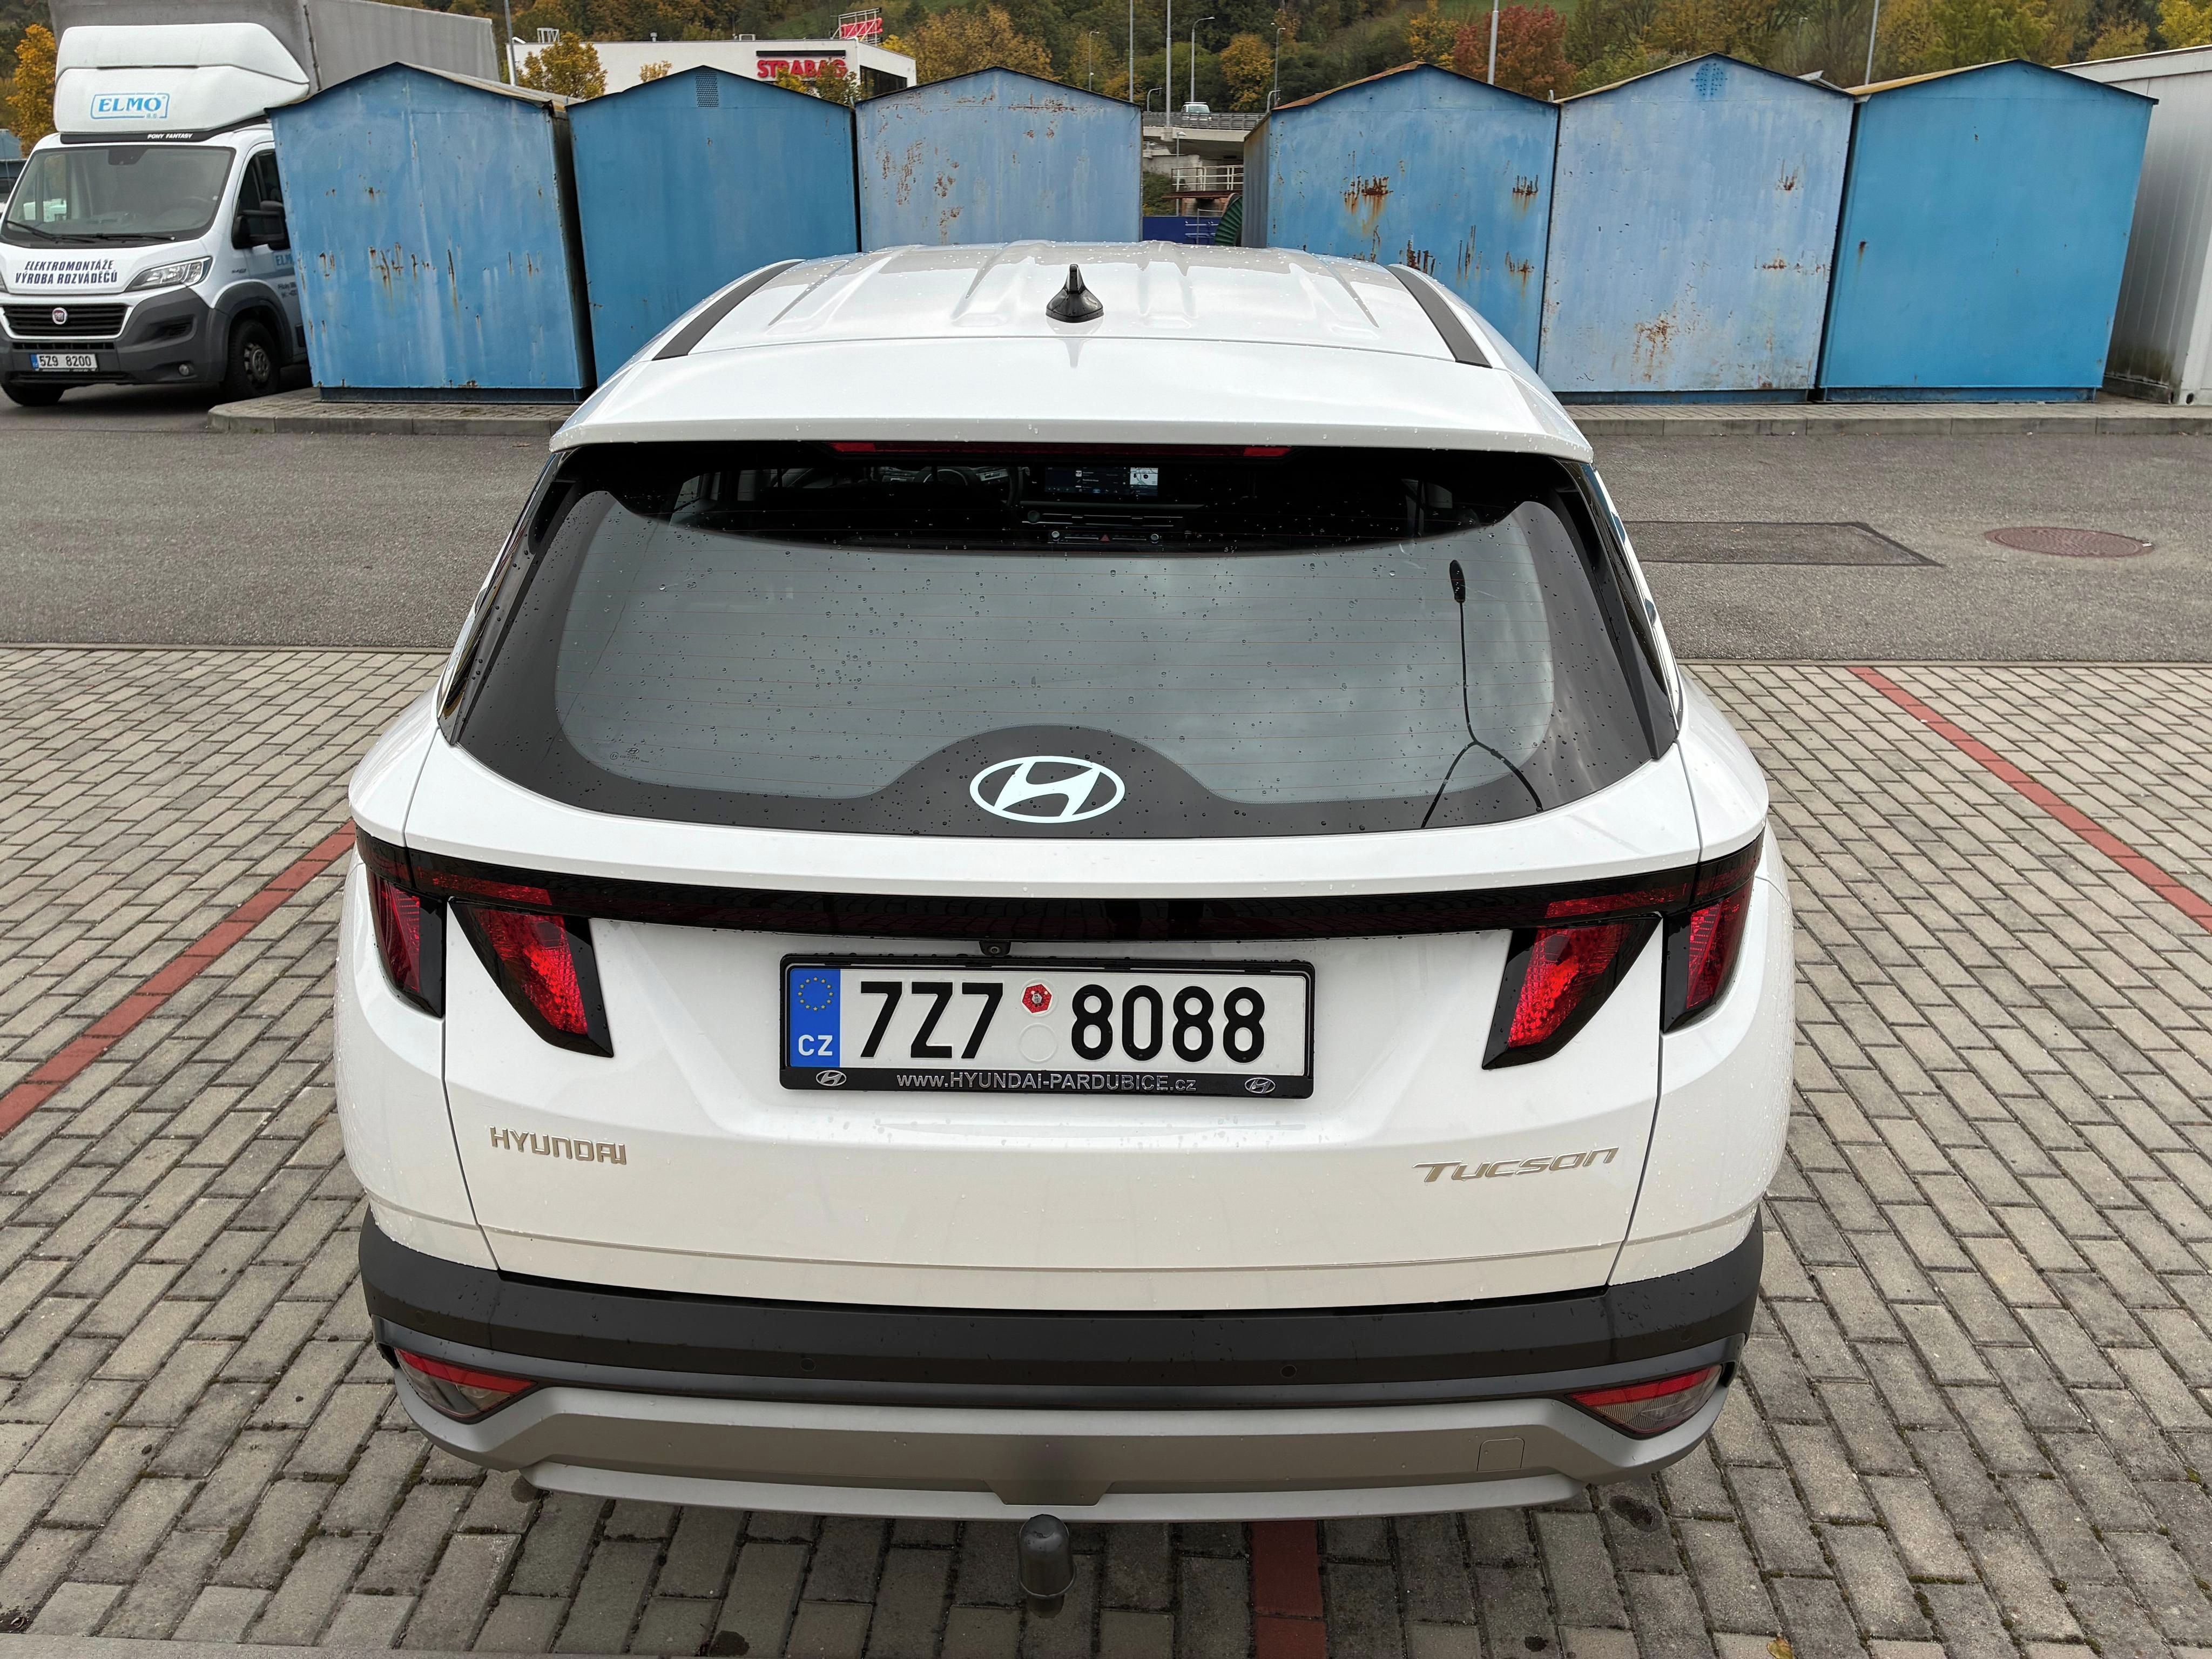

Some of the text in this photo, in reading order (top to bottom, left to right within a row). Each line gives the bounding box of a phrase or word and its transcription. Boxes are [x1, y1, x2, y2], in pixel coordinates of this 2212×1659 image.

[98, 97, 161, 112] ELMO
[24, 259, 114, 271] ELEKTROMONTÁŽE
[15, 271, 53, 284] VÝROBA
[39, 355, 91, 367] 5Z9 8200
[860, 981, 1265, 1063] 7Z7 8088
[798, 1034, 833, 1056] CZ
[489, 1125, 627, 1165] HYUNDAI
